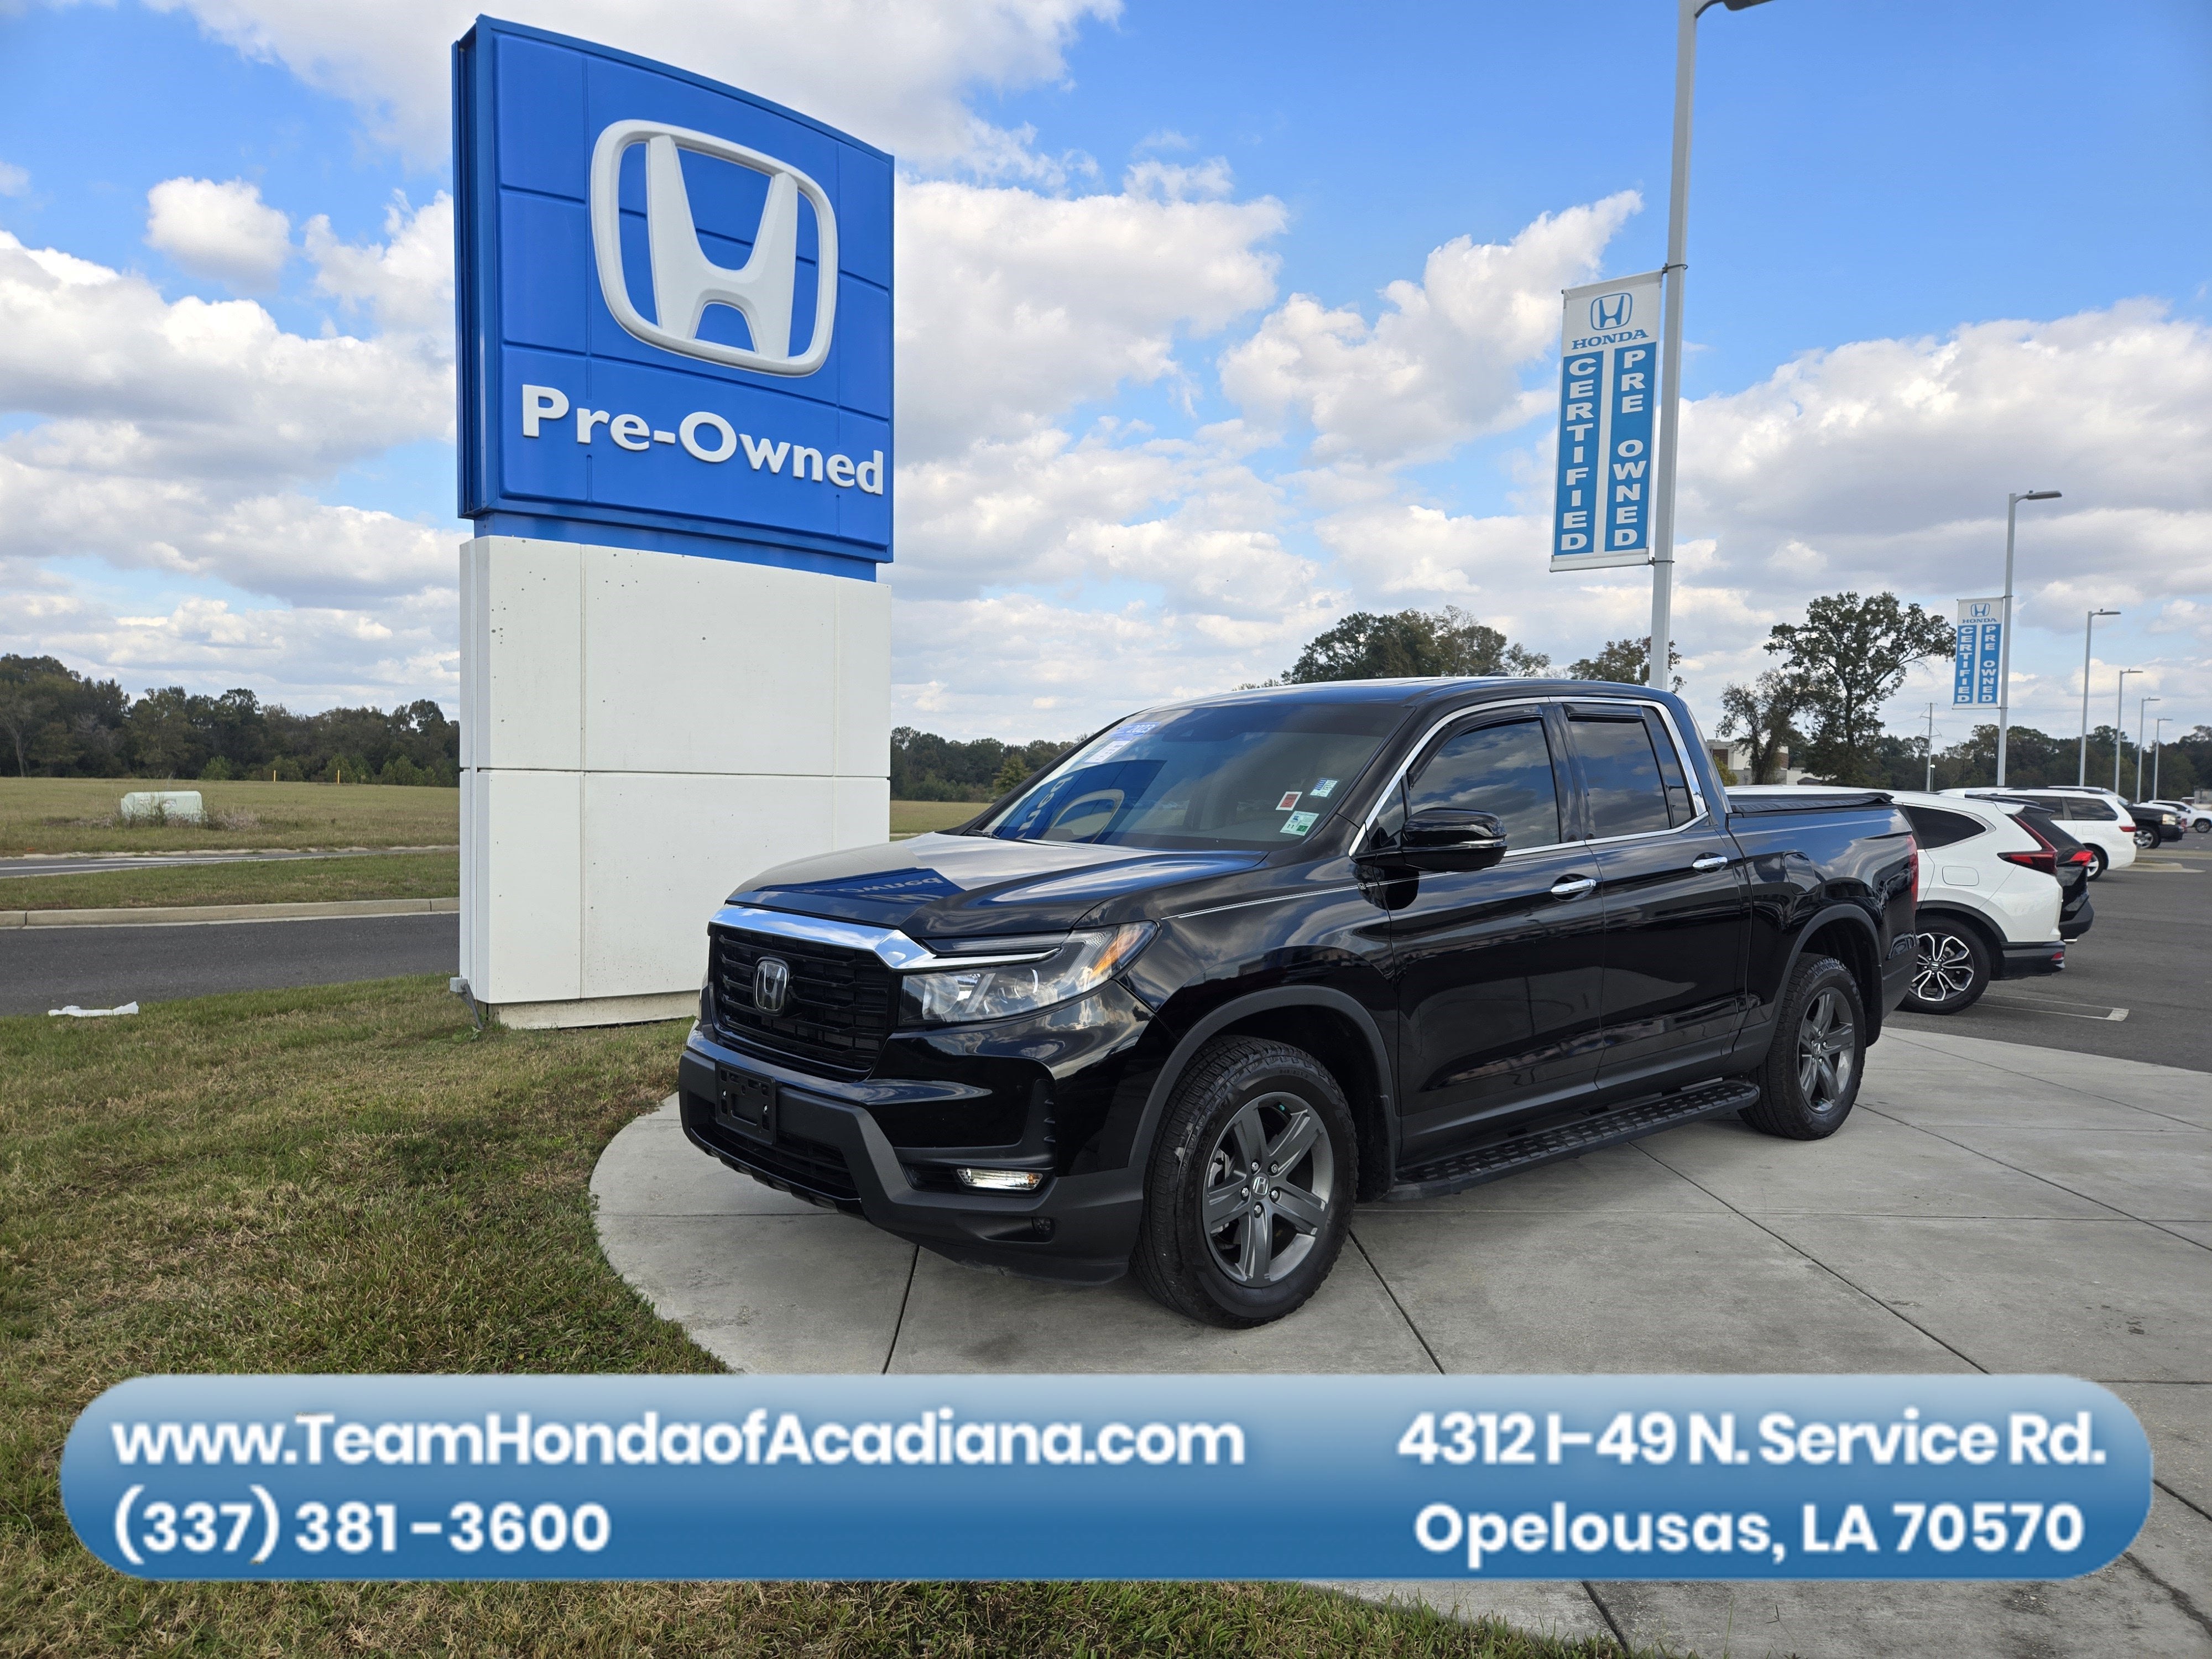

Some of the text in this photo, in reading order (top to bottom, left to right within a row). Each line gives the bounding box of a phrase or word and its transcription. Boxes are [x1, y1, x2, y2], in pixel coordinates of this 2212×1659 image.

[1572, 328, 1649, 350] HONDA
[522, 384, 883, 495] Pre-Owned
[1561, 358, 1597, 551] CERTIFIED
[1613, 349, 1647, 546] PRE OWNED
[1957, 627, 1974, 702] CERTIFIED
[1981, 626, 1996, 702] PRE OWNED
[1126, 724, 1156, 733] 2023
